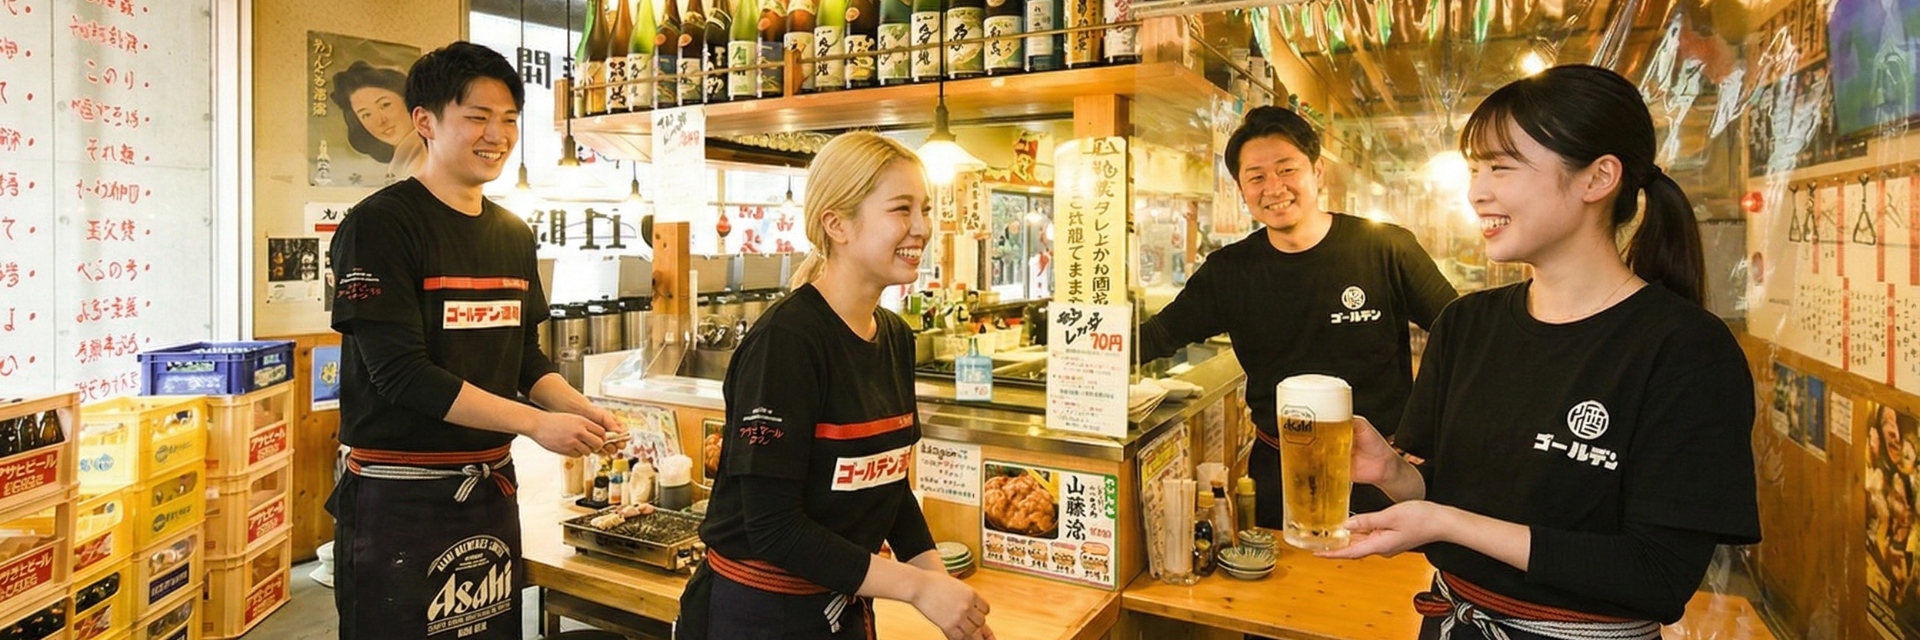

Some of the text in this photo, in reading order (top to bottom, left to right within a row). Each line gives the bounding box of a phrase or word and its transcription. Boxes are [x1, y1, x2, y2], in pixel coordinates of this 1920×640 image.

[1330, 309, 1382, 323] ゴールデン
[1090, 333, 1122, 352] 70円
[1533, 433, 1618, 470] ゴールデン
[427, 559, 512, 621] Asahi
